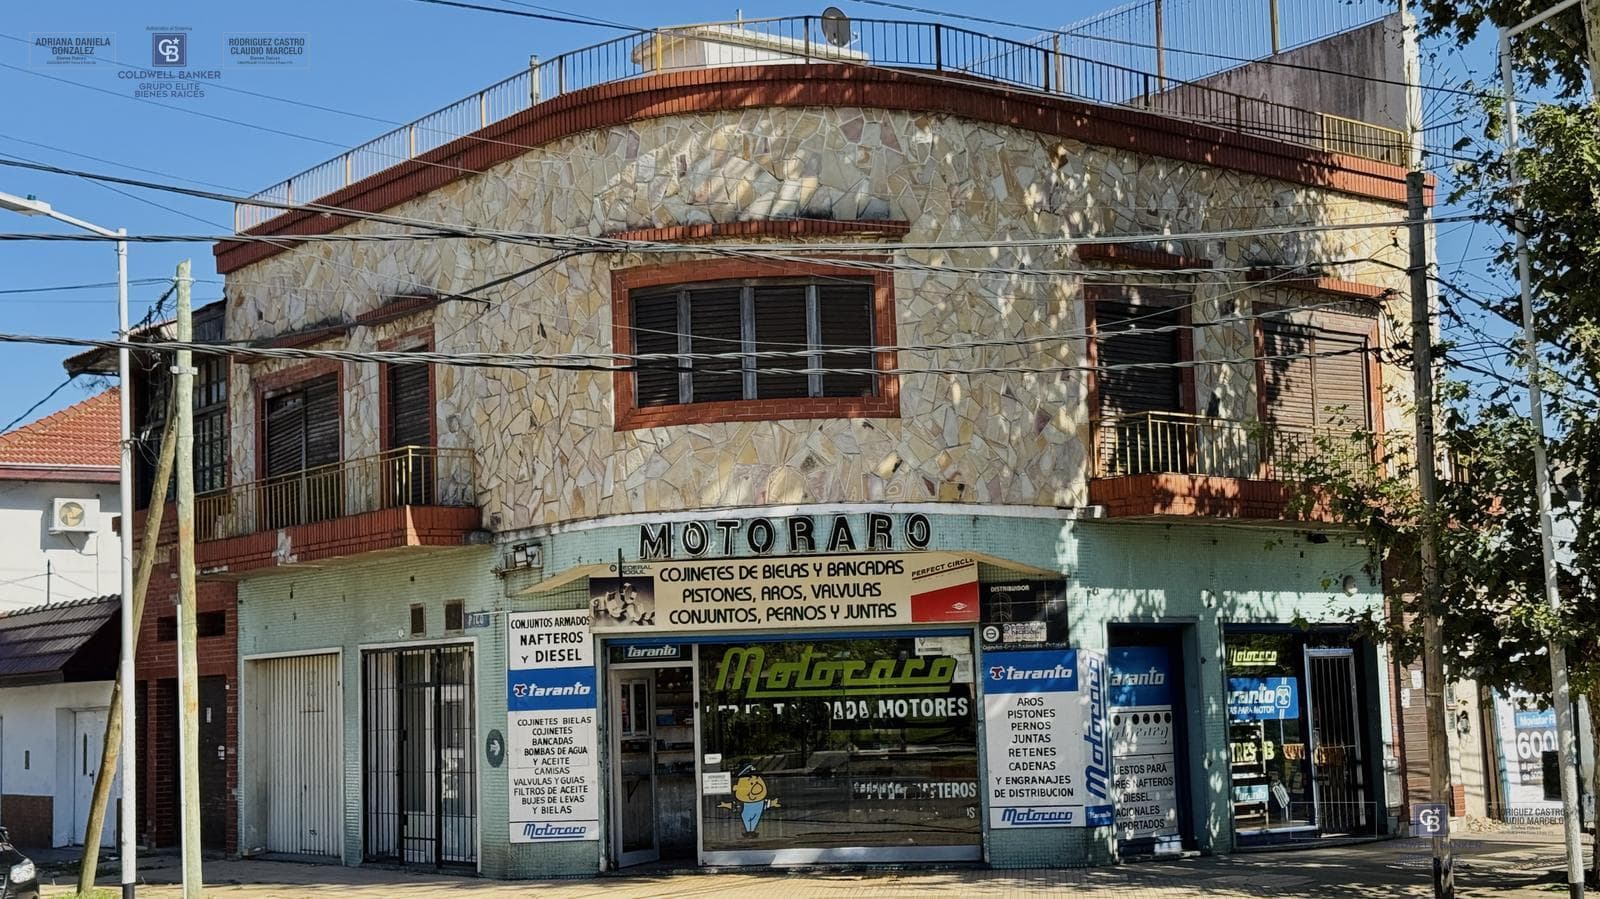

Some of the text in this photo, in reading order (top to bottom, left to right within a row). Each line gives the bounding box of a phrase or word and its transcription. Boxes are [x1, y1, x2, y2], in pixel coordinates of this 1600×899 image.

[639, 512, 932, 559] MOTORARO
[659, 560, 904, 582] COJINETES DE BIELAS Y BANCADAS
[911, 563, 946, 578] PERFECT
[682, 582, 881, 603] PISTONES, AROS, VALVULAS
[669, 603, 897, 624] CONJUNTOS, PERNOS Y JUNTAS
[510, 616, 590, 629] CONJUNTOS ARMADOS
[520, 631, 583, 646] NAFTEROS
[521, 648, 582, 663] Y DIESEL
[627, 644, 677, 658] taranto
[1006, 664, 1073, 680] taranto
[528, 681, 591, 697] taranto
[1017, 697, 1044, 706] AROS
[879, 697, 969, 719] MOTORES
[1007, 709, 1056, 719] PISTONES
[517, 716, 592, 726] COJINETES BIELAS
[532, 726, 573, 735] COJINETES
[1011, 722, 1051, 731] PERNOS
[532, 737, 573, 746] BANCADAS
[1012, 734, 1051, 744] JUNTAS
[524, 746, 588, 756] BOMBAS DE AGUA
[1008, 747, 1056, 757] RETENES
[541, 757, 570, 765] ACEITE
[1008, 761, 1056, 771] CADENAS
[534, 767, 570, 775] CAMISAS
[1146, 763, 1168, 773] PARA
[513, 776, 585, 786] VALVULAS Y GUIAS
[995, 775, 1072, 785] Y ENGRANAJES
[1132, 777, 1174, 788] NAFTEROS
[513, 785, 588, 796] FILTROS DE ACEITE
[994, 787, 1074, 798] DE DISTRIBUCION
[521, 795, 585, 805] BUJES DE LEVAS
[541, 806, 572, 814] BIELAS
